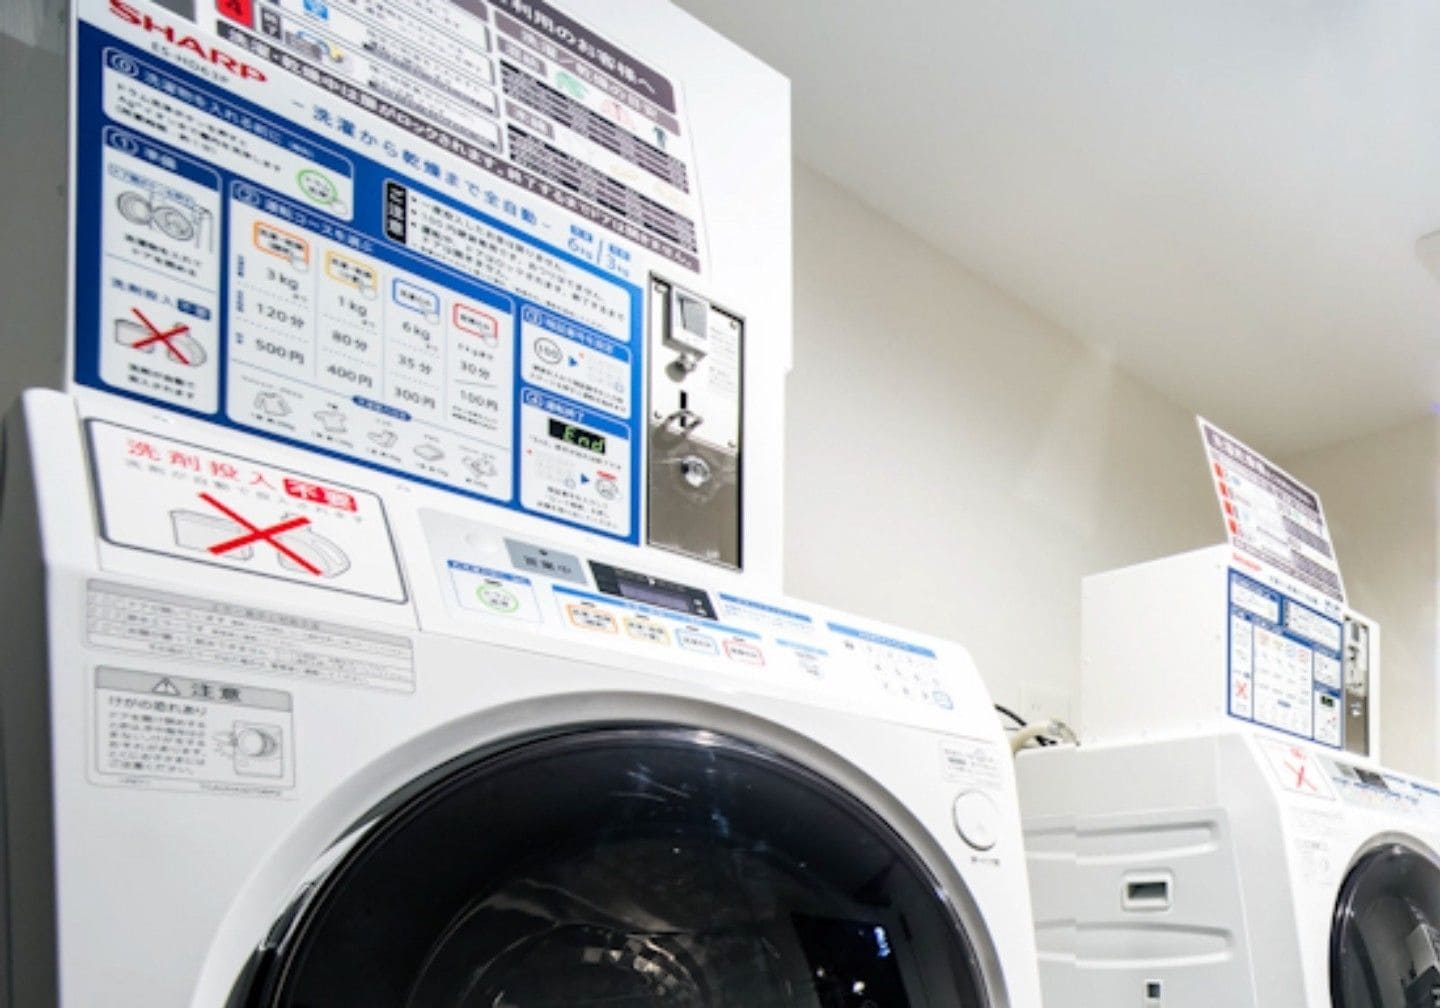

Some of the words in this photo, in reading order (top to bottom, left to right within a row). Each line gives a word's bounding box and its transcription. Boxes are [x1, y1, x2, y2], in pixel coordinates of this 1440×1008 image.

[108, 0, 267, 82] SHARP
[127, 437, 275, 491] 洗剤投入
[565, 423, 604, 454] End
